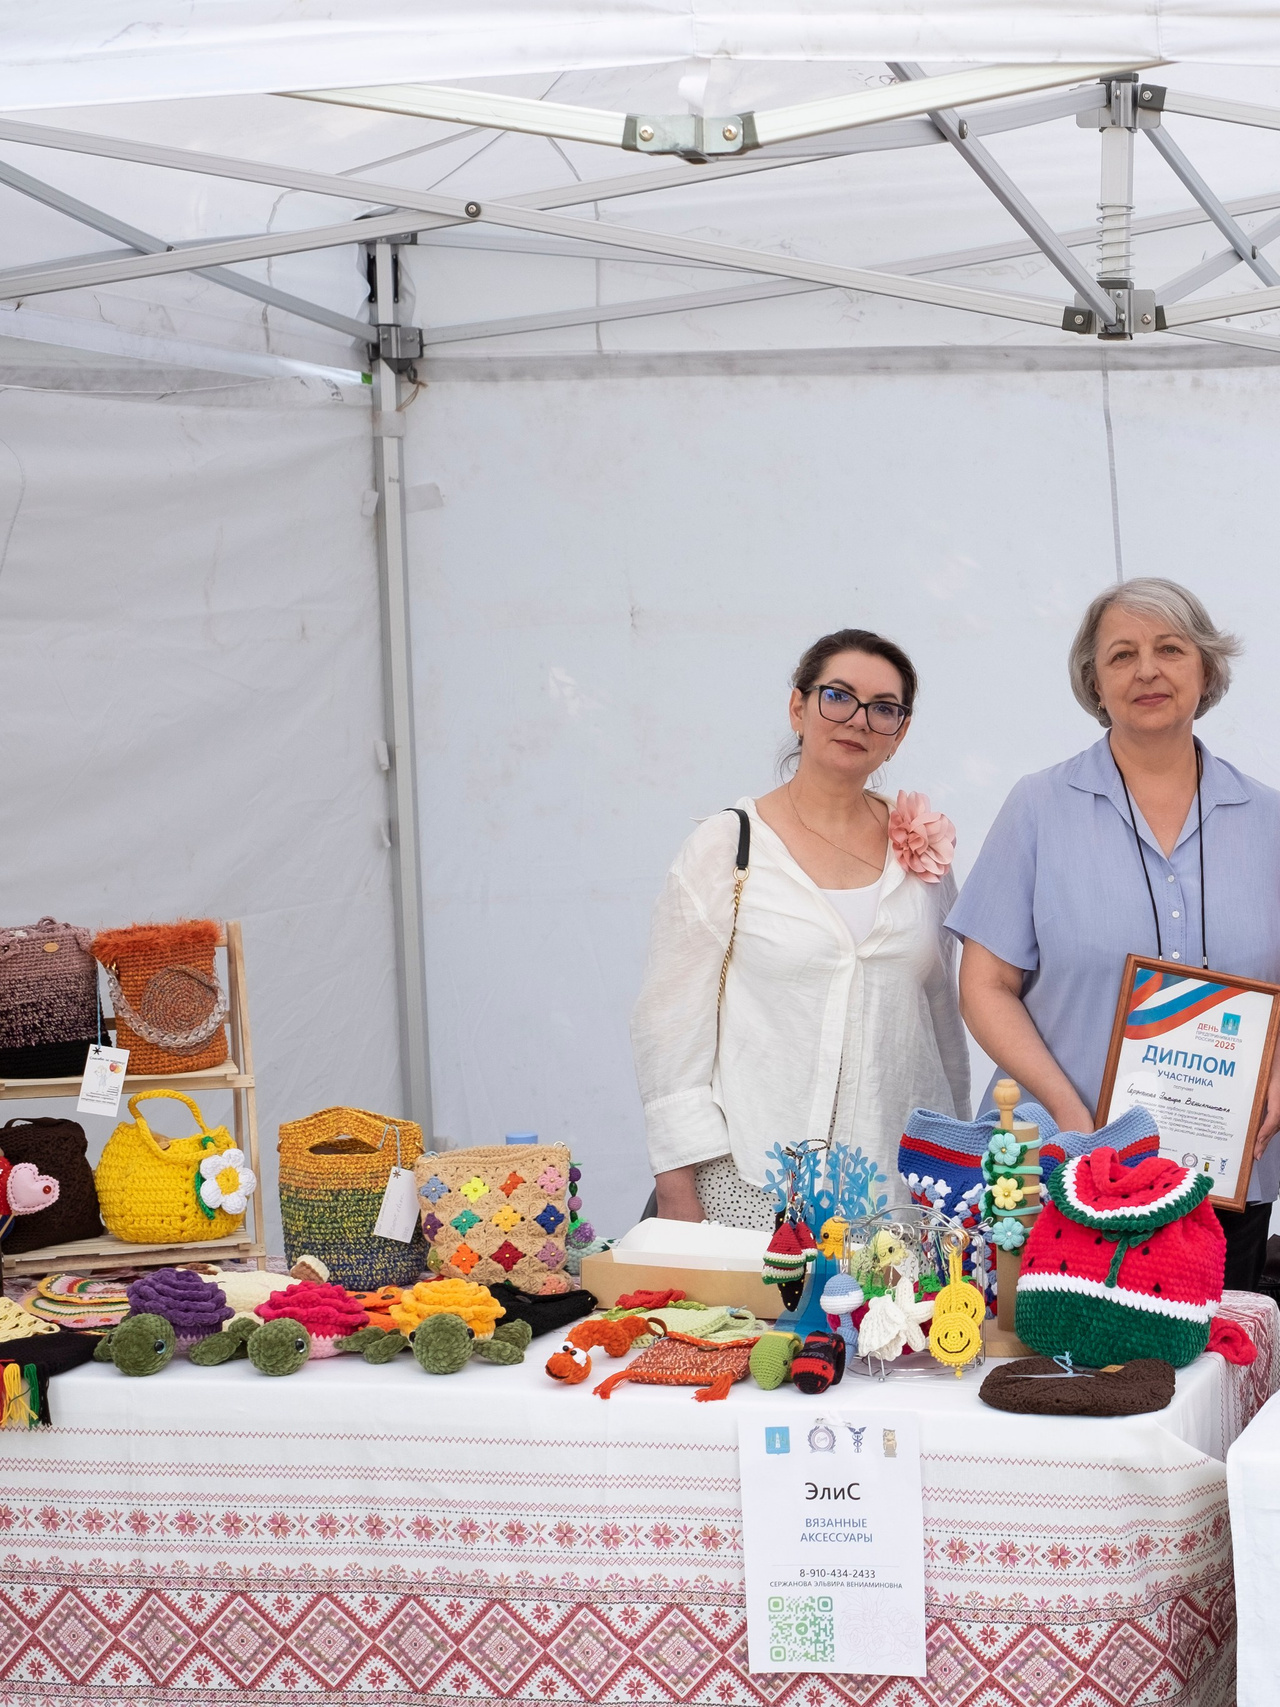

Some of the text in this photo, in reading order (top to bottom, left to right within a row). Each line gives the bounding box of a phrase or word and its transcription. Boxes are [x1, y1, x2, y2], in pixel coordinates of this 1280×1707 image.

[1197, 1022, 1219, 1032] ДЕНЬ
[1196, 1030, 1242, 1042] ПРЕДПРИНИМАТЕЛЯ
[1214, 1040, 1236, 1050] 2025
[1142, 1044, 1236, 1078] ДИПЛОМ
[1157, 1070, 1214, 1088] УЧАСТНИКА
[805, 1482, 860, 1500] ЭлиС
[806, 1518, 868, 1528] ВЯЗАННЫЕ
[800, 1532, 872, 1542] АКСЕССУАРЫ
[800, 1568, 876, 1578] 8-910-434-2433
